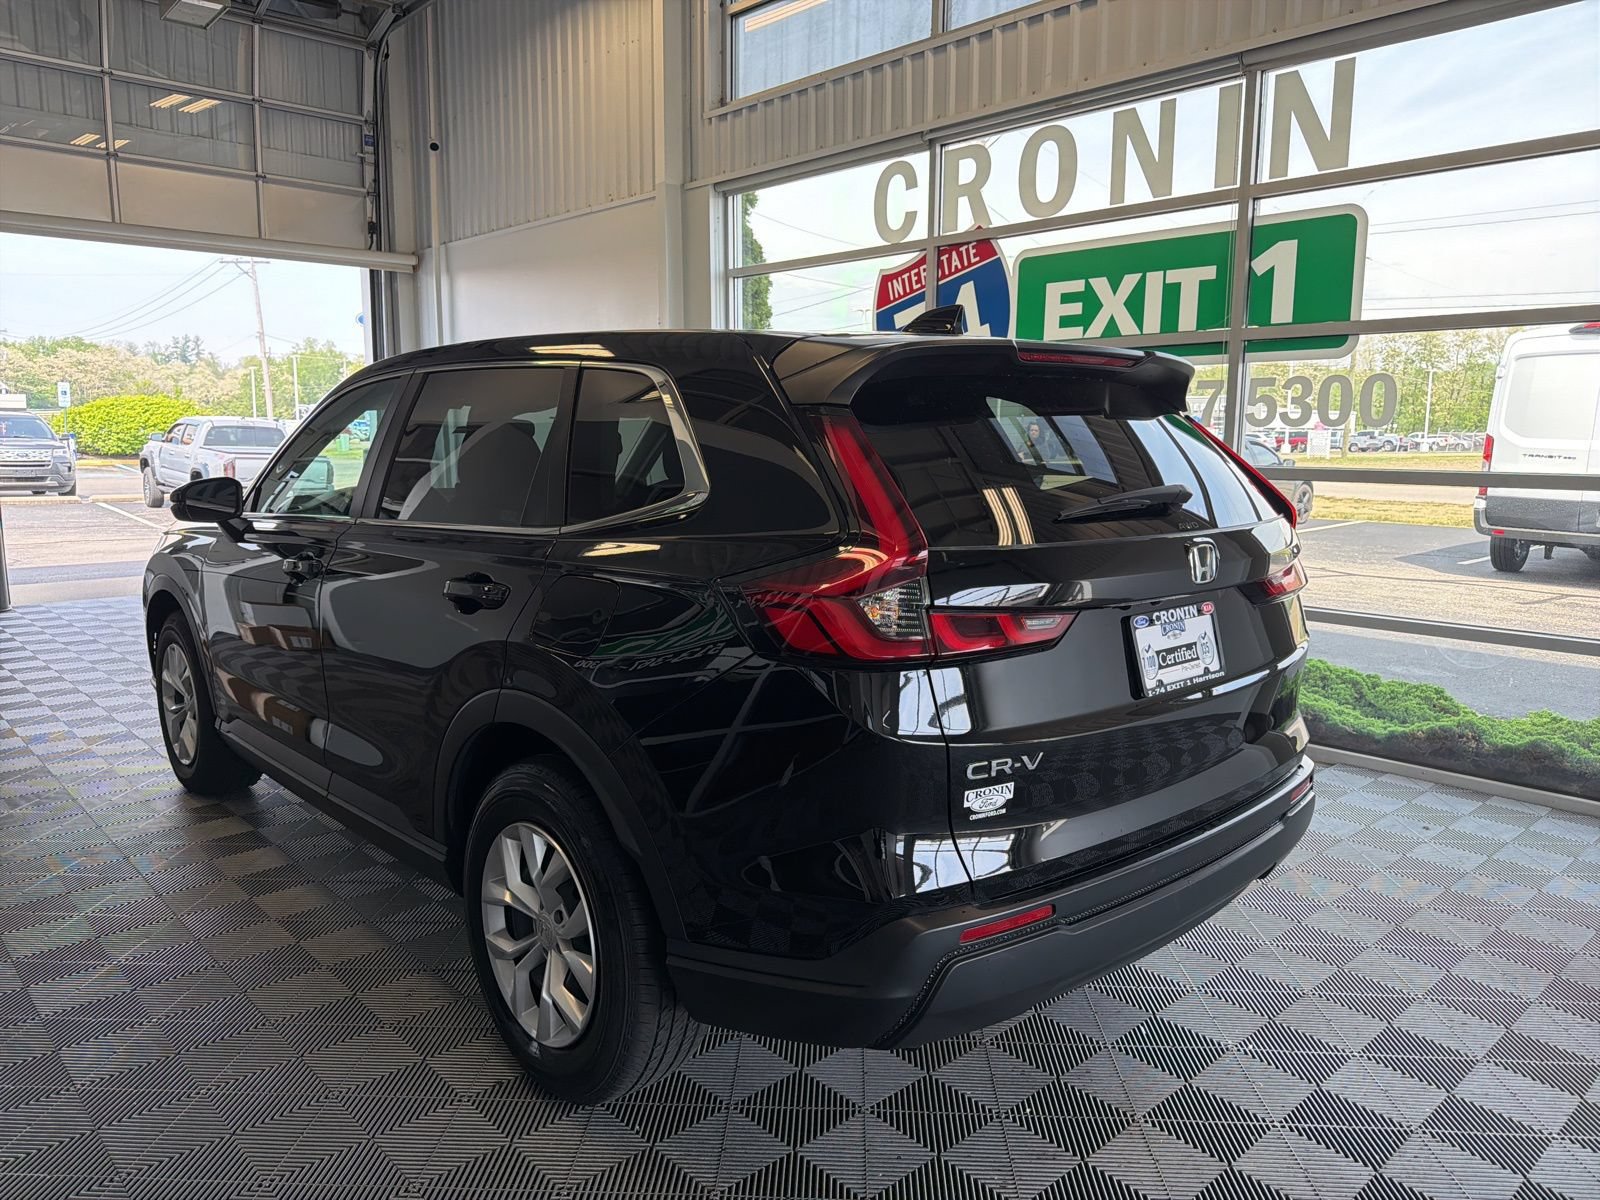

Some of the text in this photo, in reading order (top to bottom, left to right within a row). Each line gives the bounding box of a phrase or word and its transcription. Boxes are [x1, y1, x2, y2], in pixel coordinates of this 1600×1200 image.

[874, 57, 1356, 243] CRONIN
[887, 242, 980, 301] INTERTATE
[1043, 239, 1298, 341] EXIT 1
[1153, 605, 1198, 625] CRONIN
[1161, 620, 1186, 636] CRONIN
[1159, 645, 1198, 666] Certified
[1147, 685, 1165, 697] I-74
[1167, 680, 1185, 692] EXIT
[1193, 671, 1225, 684] Harrison
[966, 752, 1044, 780] CR-V
[966, 783, 1013, 803] CRONIN
[978, 797, 999, 809] Ford
